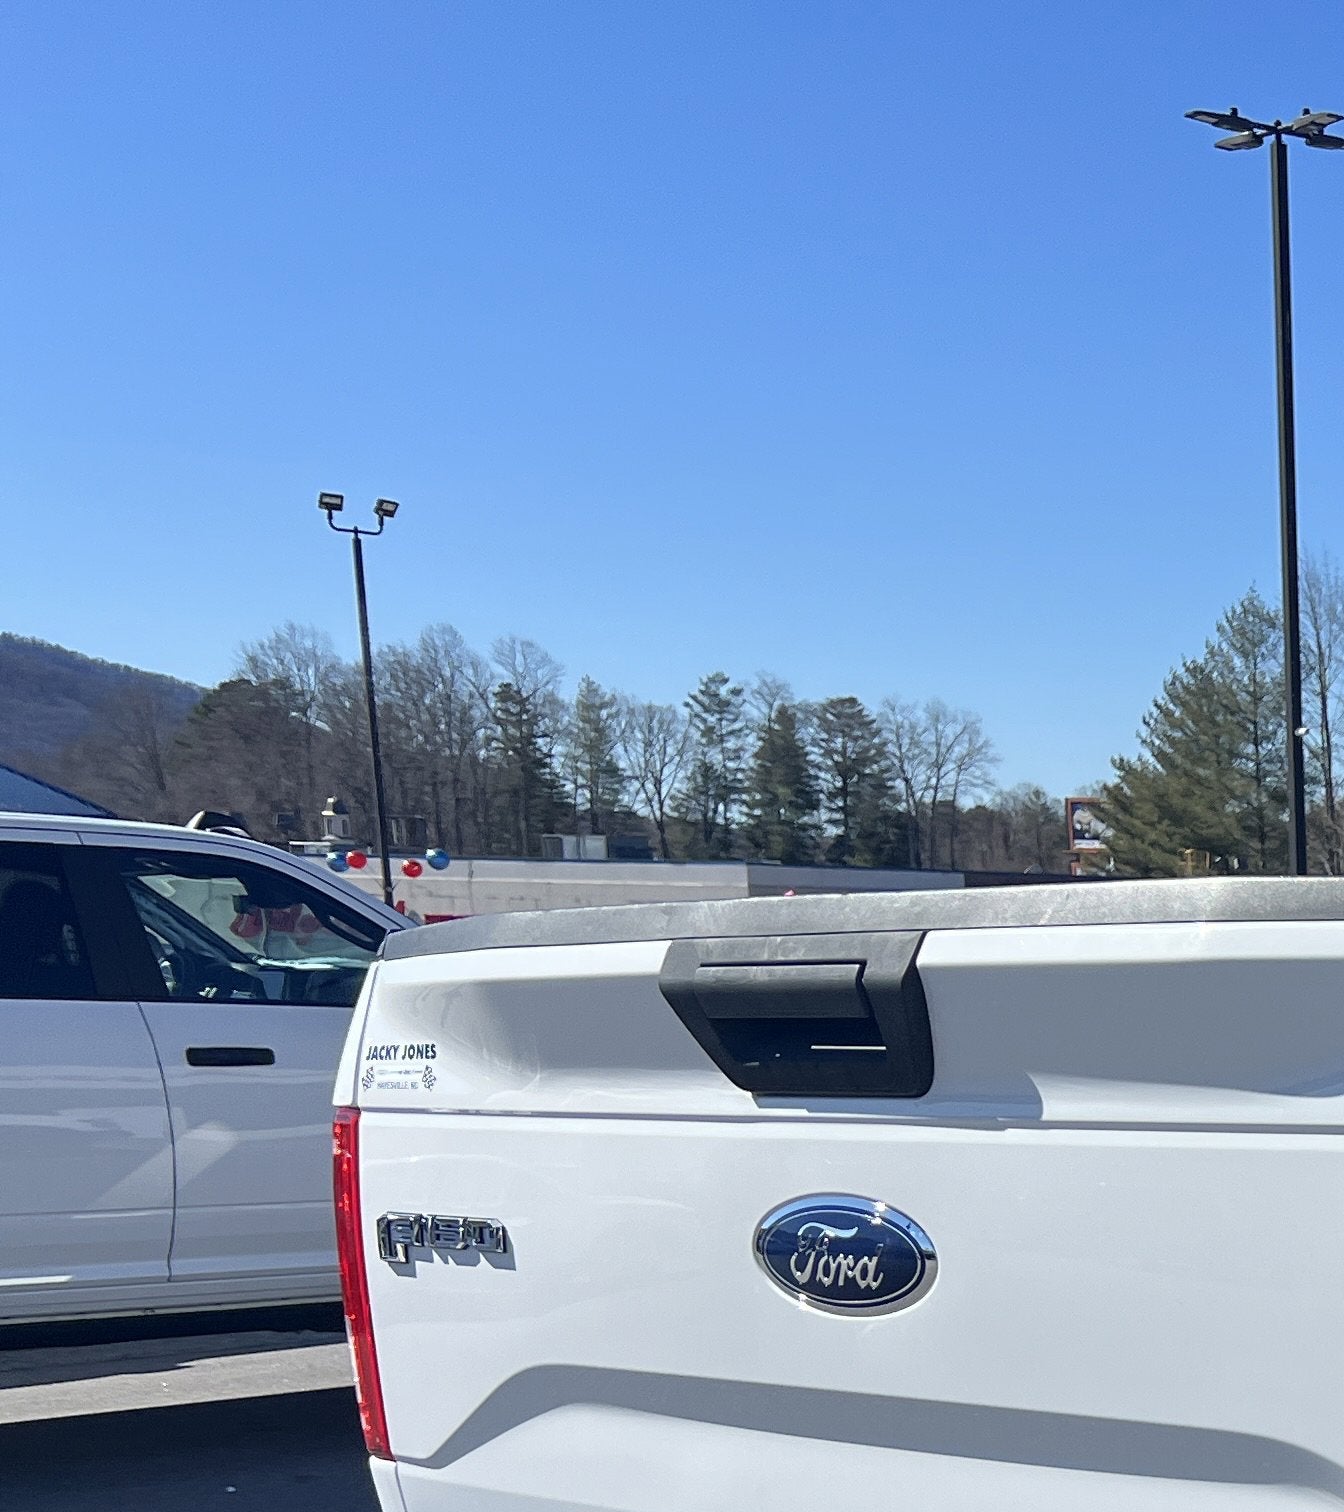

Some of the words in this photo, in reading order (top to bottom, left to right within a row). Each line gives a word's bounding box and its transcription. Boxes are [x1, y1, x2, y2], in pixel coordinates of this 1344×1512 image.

[366, 1045, 400, 1061] JACKY
[402, 1043, 437, 1061] JONES
[789, 1221, 885, 1291] Ford
